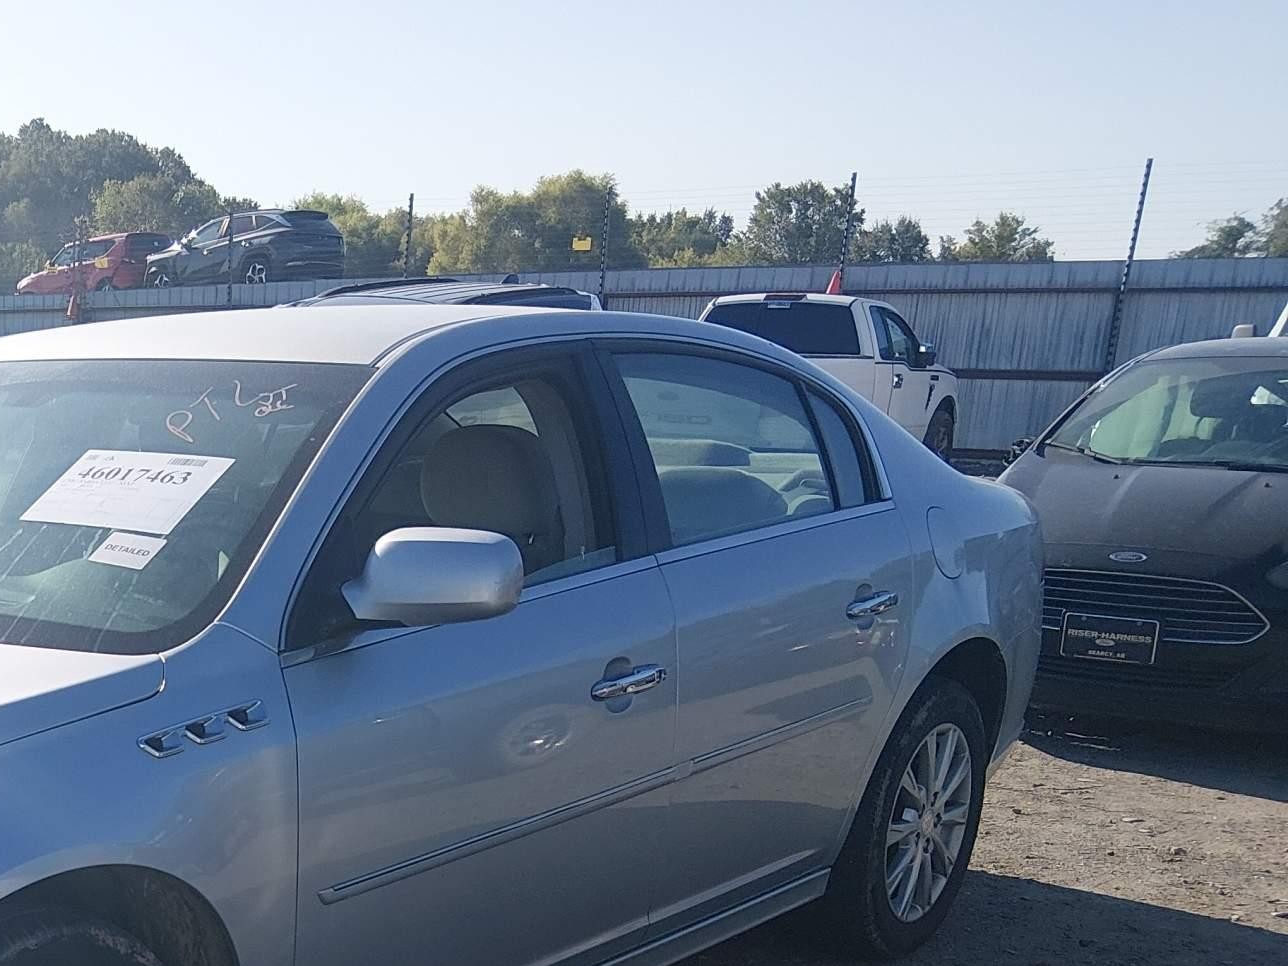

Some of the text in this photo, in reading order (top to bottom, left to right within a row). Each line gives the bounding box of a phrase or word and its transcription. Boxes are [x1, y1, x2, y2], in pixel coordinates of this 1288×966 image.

[78, 465, 193, 486] 46017463
[104, 543, 151, 558] DETAILED
[1067, 628, 1153, 644] RISER-HARNESS
